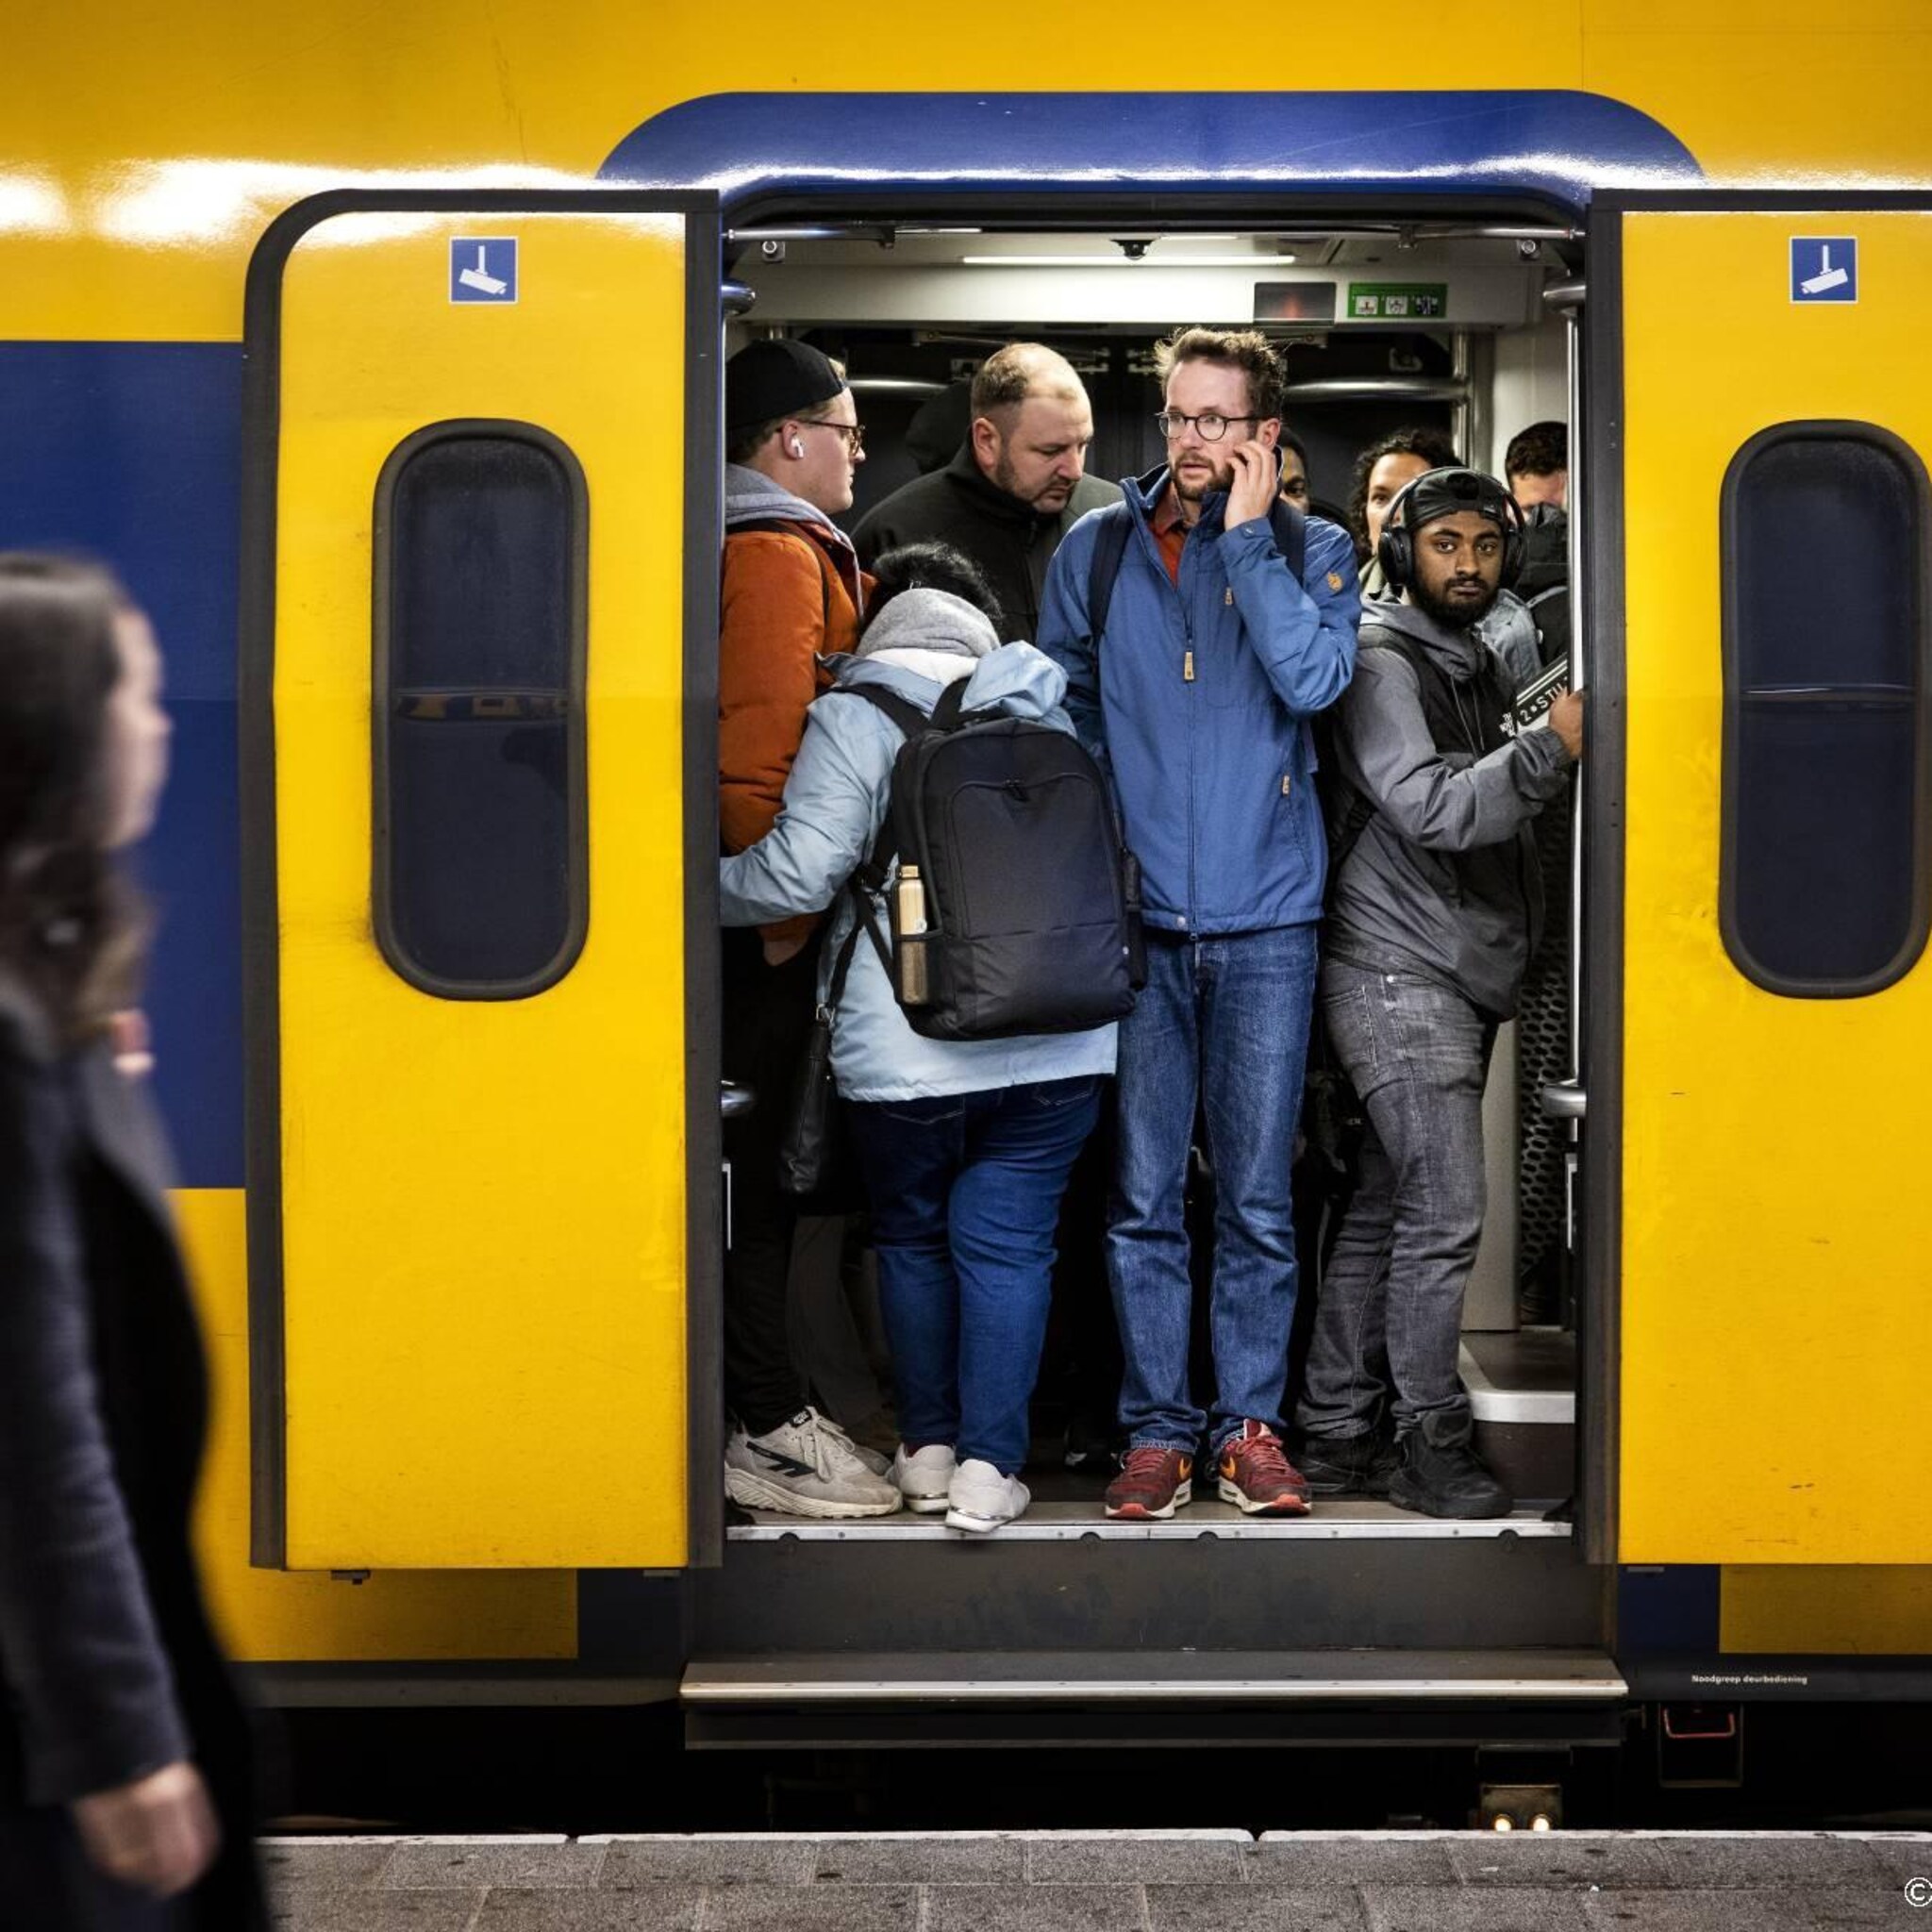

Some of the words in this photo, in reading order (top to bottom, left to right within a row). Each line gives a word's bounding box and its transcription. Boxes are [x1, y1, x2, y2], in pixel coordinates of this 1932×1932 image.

[1520, 709, 1531, 722] 2
[1691, 1674, 1741, 1685] Noodgreep
[1742, 1674, 1807, 1685] deurbediening
